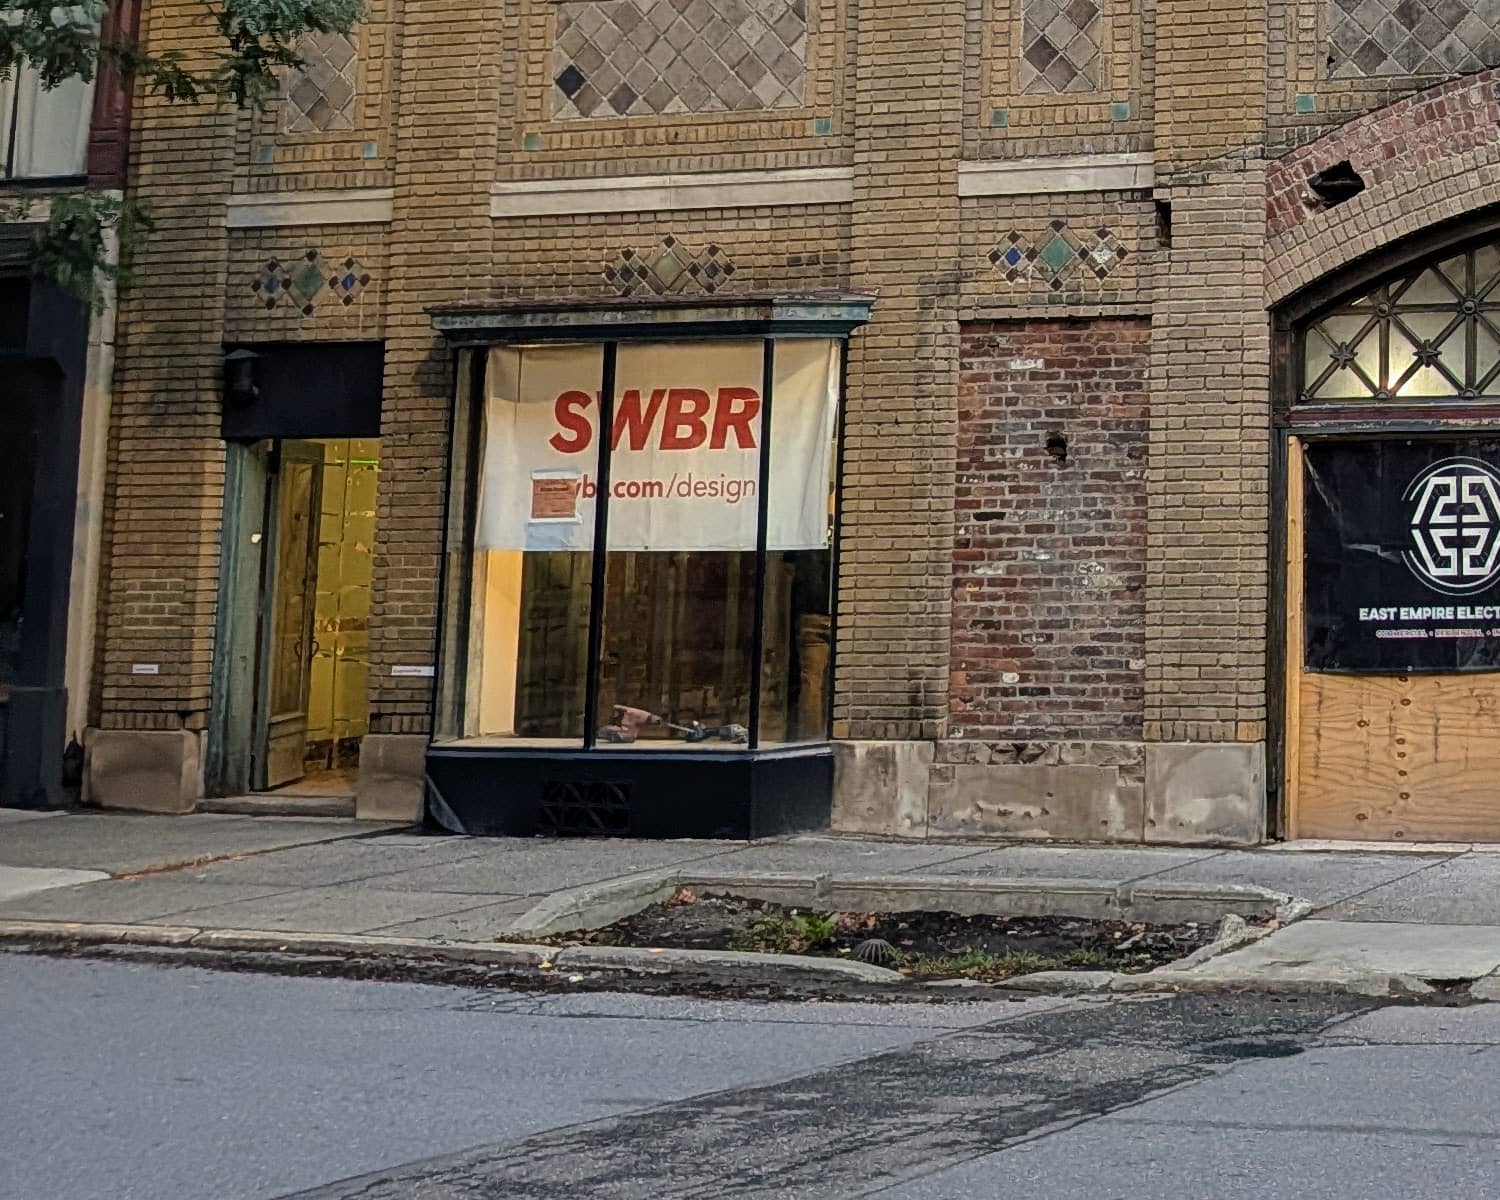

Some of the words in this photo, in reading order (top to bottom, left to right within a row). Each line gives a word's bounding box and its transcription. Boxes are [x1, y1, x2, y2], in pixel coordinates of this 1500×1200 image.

[549, 387, 760, 453] SWBR
[575, 472, 755, 504] b.com/design
[1359, 607, 1398, 621] EAST
[1400, 607, 1454, 620] EMPIRE
